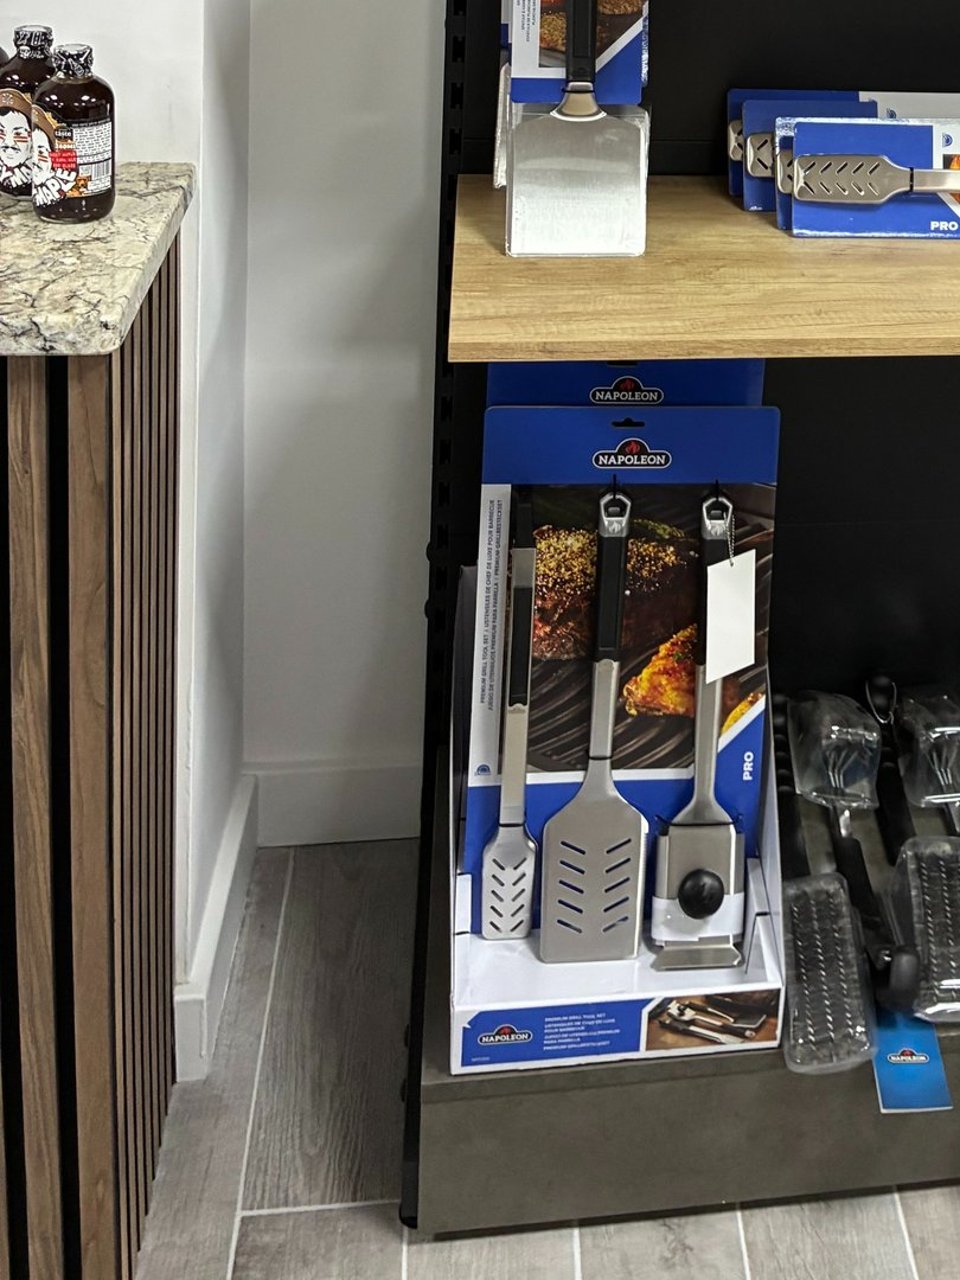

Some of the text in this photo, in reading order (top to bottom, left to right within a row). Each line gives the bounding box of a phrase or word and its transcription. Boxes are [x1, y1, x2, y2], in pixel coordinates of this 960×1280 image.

[35, 168, 77, 207] MAPLE
[930, 221, 958, 231] PRO
[594, 390, 658, 401] NAPOLEON
[598, 454, 666, 464] NAPOLEON
[742, 751, 754, 780] PRO
[481, 1032, 529, 1044] NAPOLEON
[890, 1054, 927, 1062] NAPOLEON
